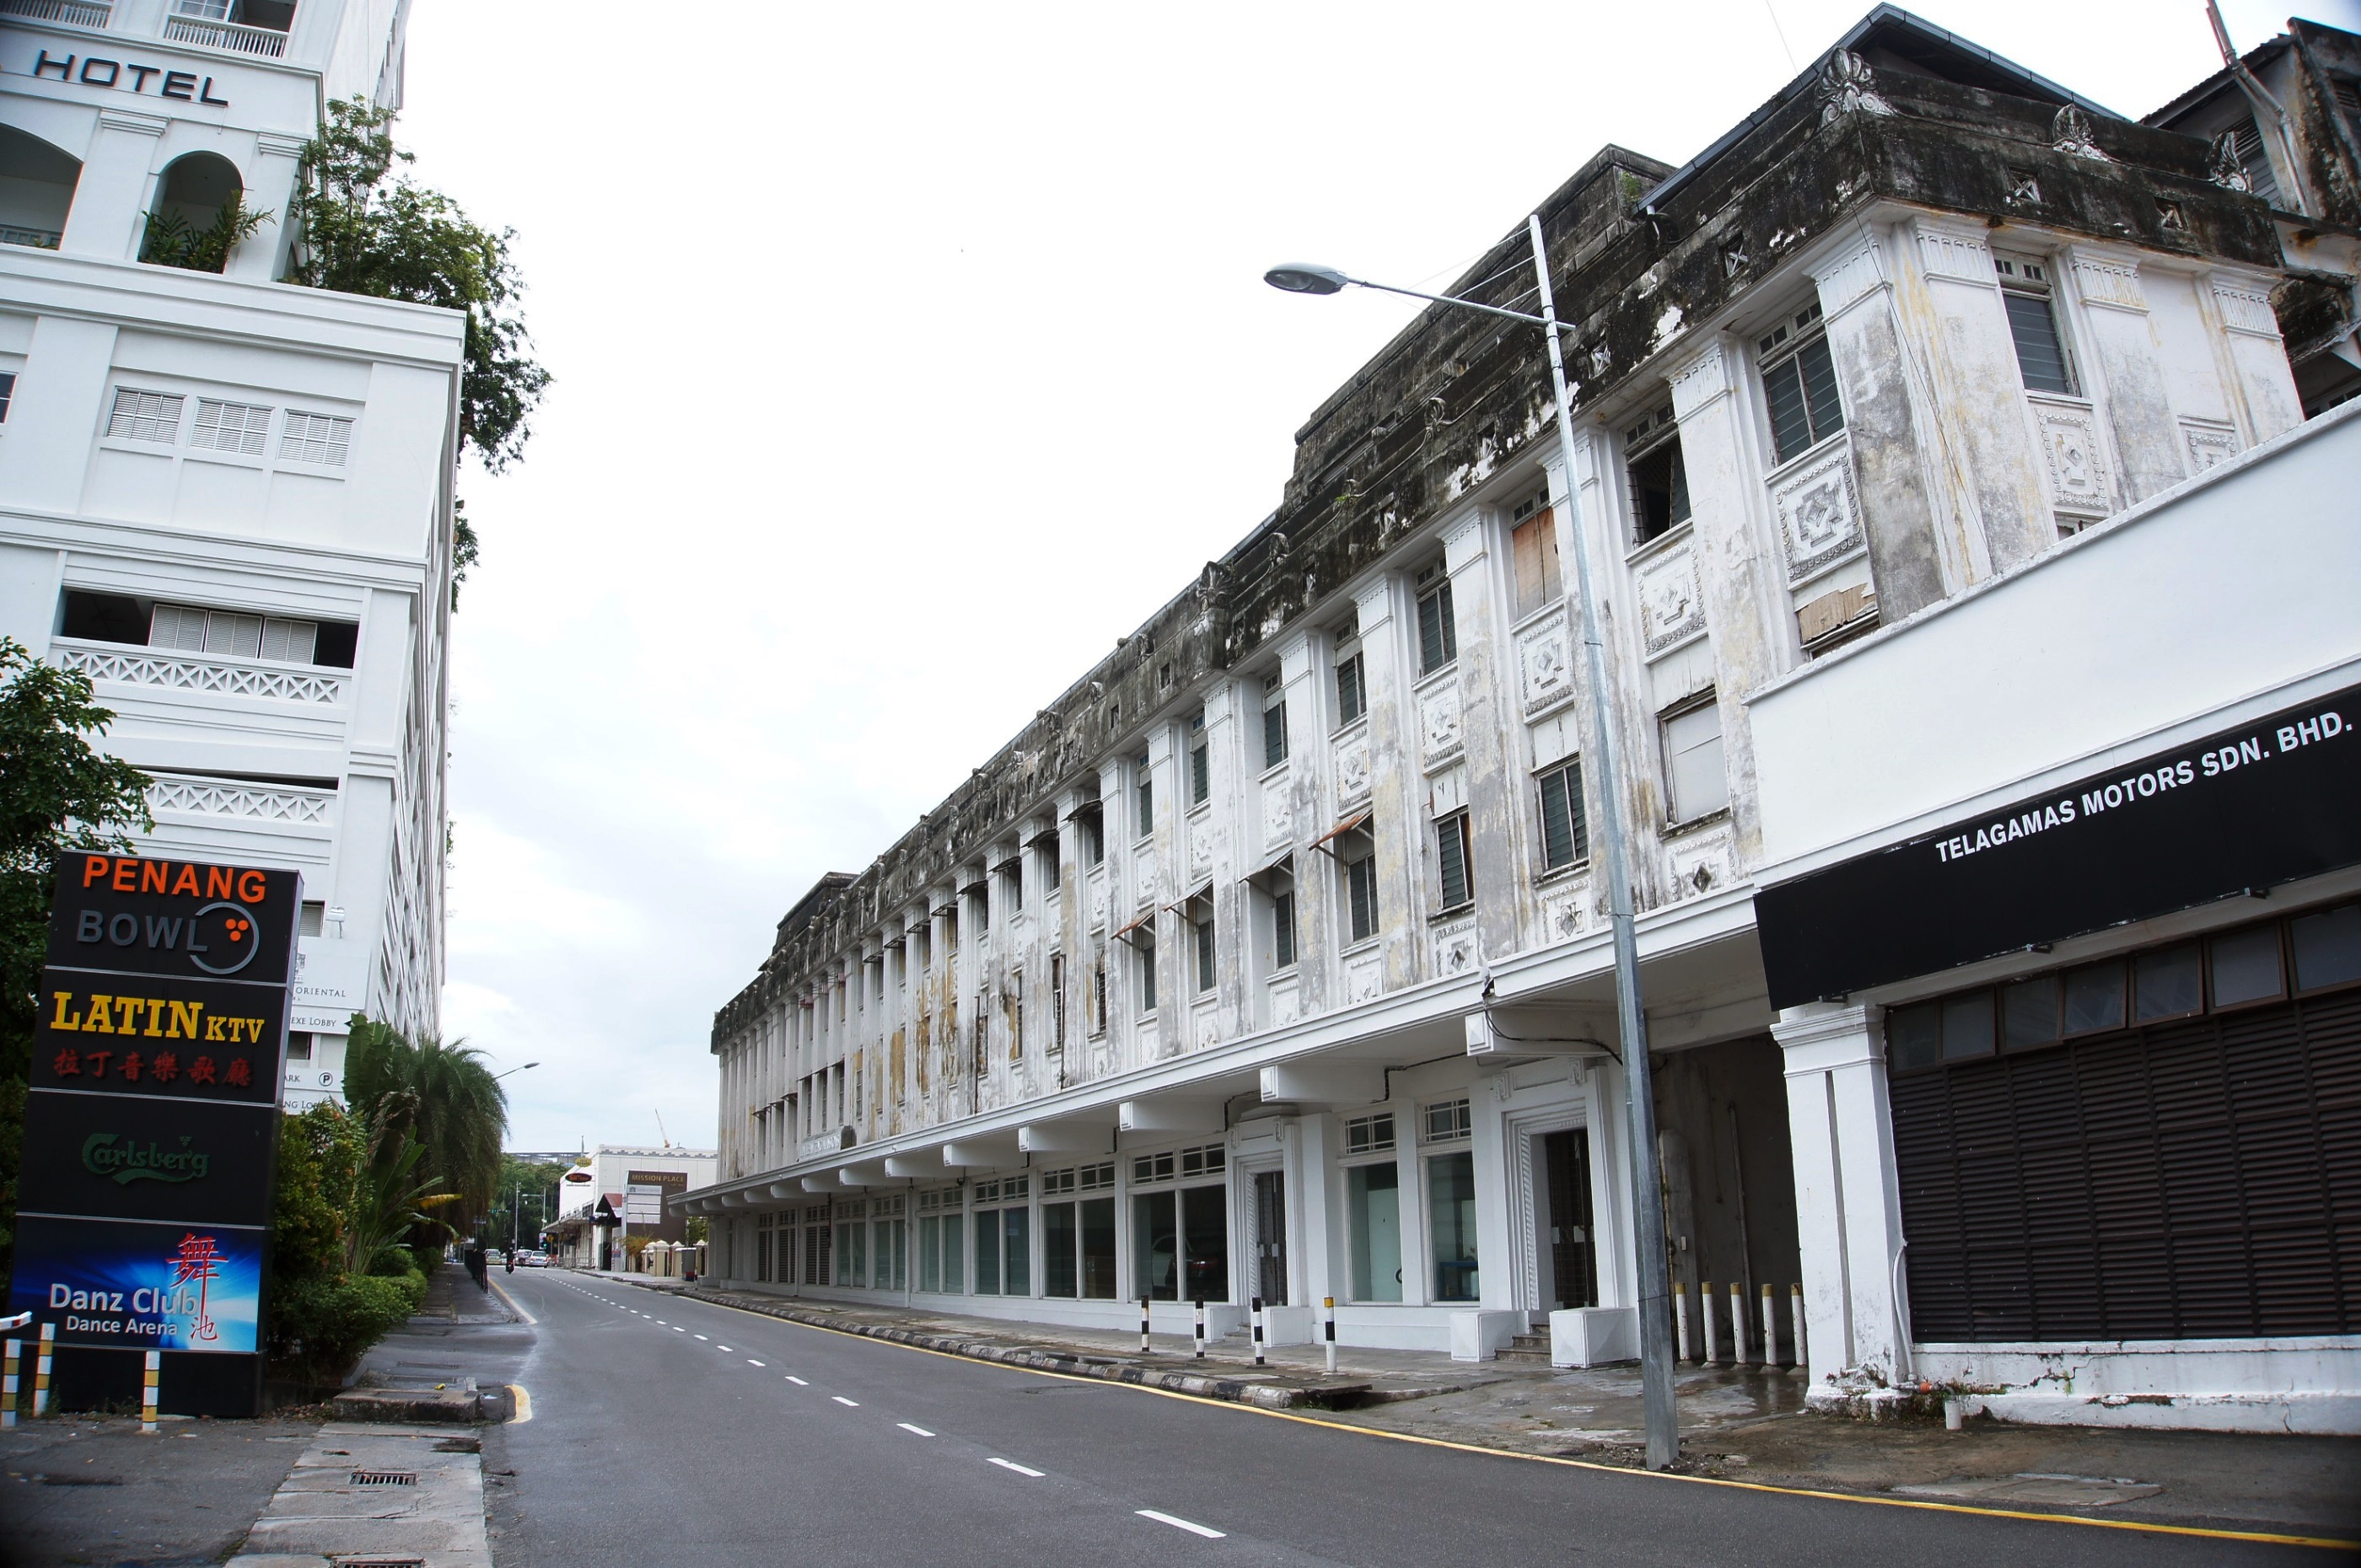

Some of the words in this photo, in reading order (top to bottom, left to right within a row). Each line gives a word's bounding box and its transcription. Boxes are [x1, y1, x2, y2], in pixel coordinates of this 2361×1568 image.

[35, 49, 229, 107] HOTEL
[1935, 800, 2076, 862] TELAGAMAS
[2081, 760, 2195, 816] MOTORS
[2202, 736, 2271, 777] SDN.
[2276, 711, 2353, 753] BHD.
[83, 855, 266, 904] PENANG
[77, 909, 208, 953] BOWL
[295, 986, 347, 997] ORIENTAL
[50, 991, 204, 1039] LATIN
[205, 1015, 266, 1044] KTV
[82, 1133, 210, 1184] Carlsberg
[49, 1283, 124, 1313] Danz
[132, 1286, 199, 1316] Club
[66, 1315, 121, 1334] Dance
[125, 1318, 178, 1336] Arena
